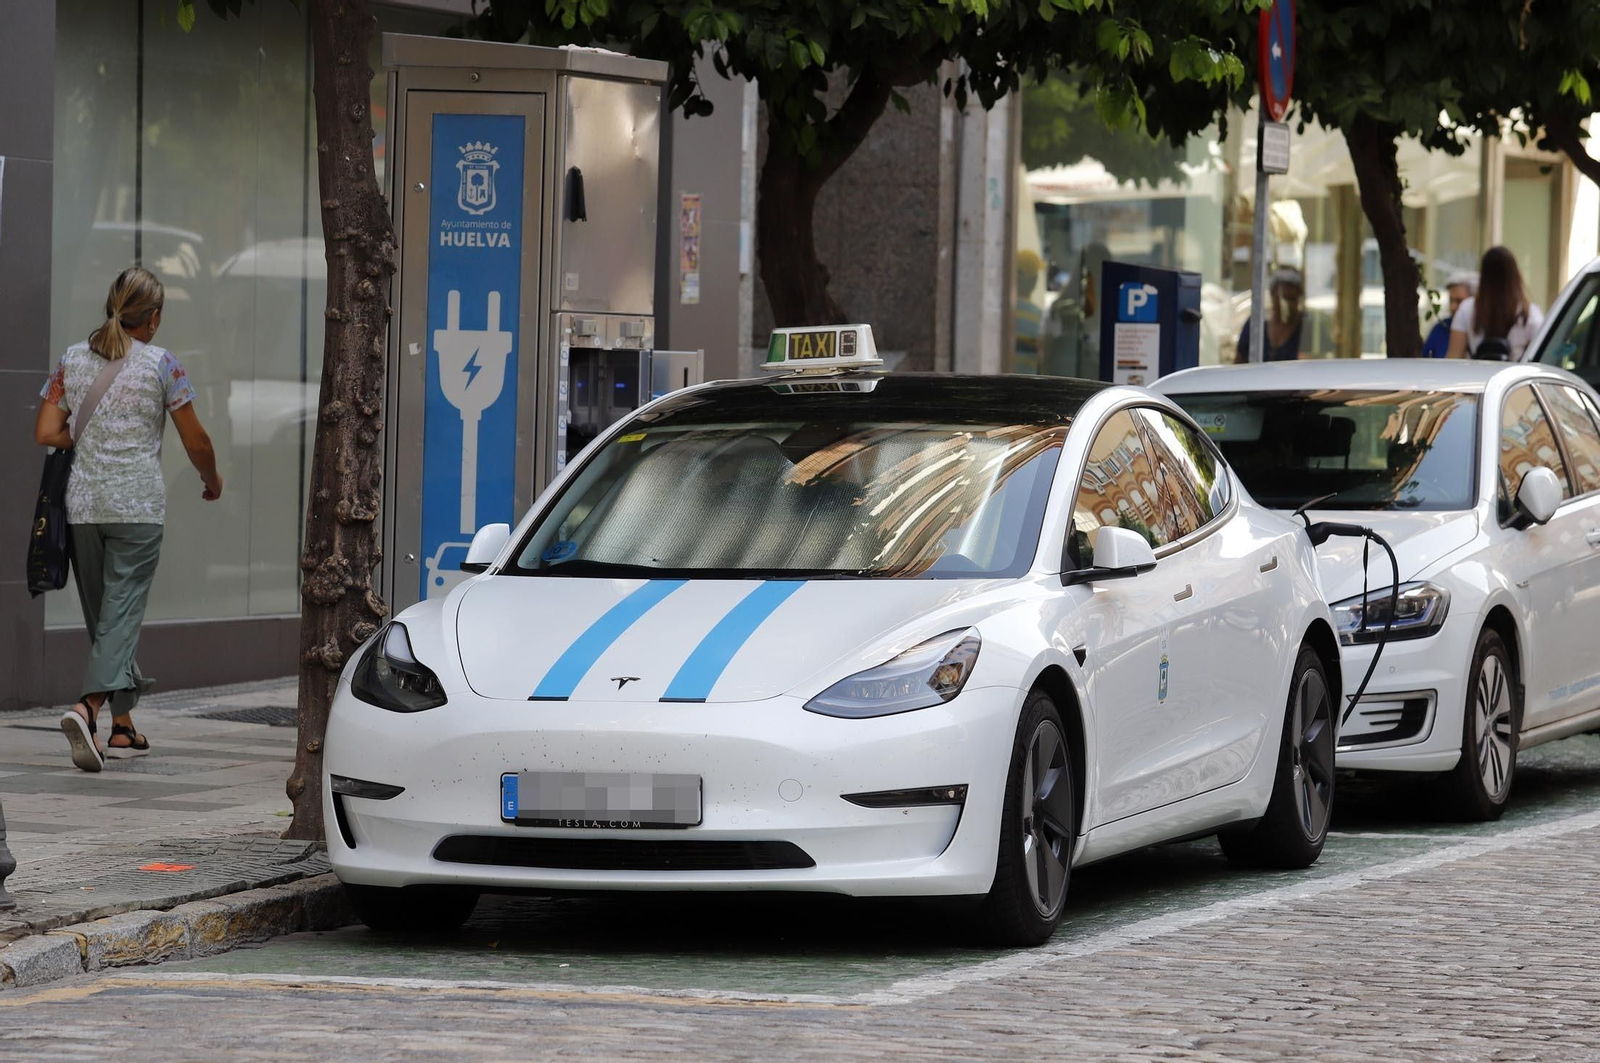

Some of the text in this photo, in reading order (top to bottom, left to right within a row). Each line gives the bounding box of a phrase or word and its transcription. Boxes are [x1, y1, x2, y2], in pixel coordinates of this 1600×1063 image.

[441, 219, 512, 230] Ayuntamiento de
[440, 231, 511, 248] HUELVA
[1127, 288, 1148, 316] P
[790, 332, 835, 359] TAXI
[507, 801, 514, 811] E
